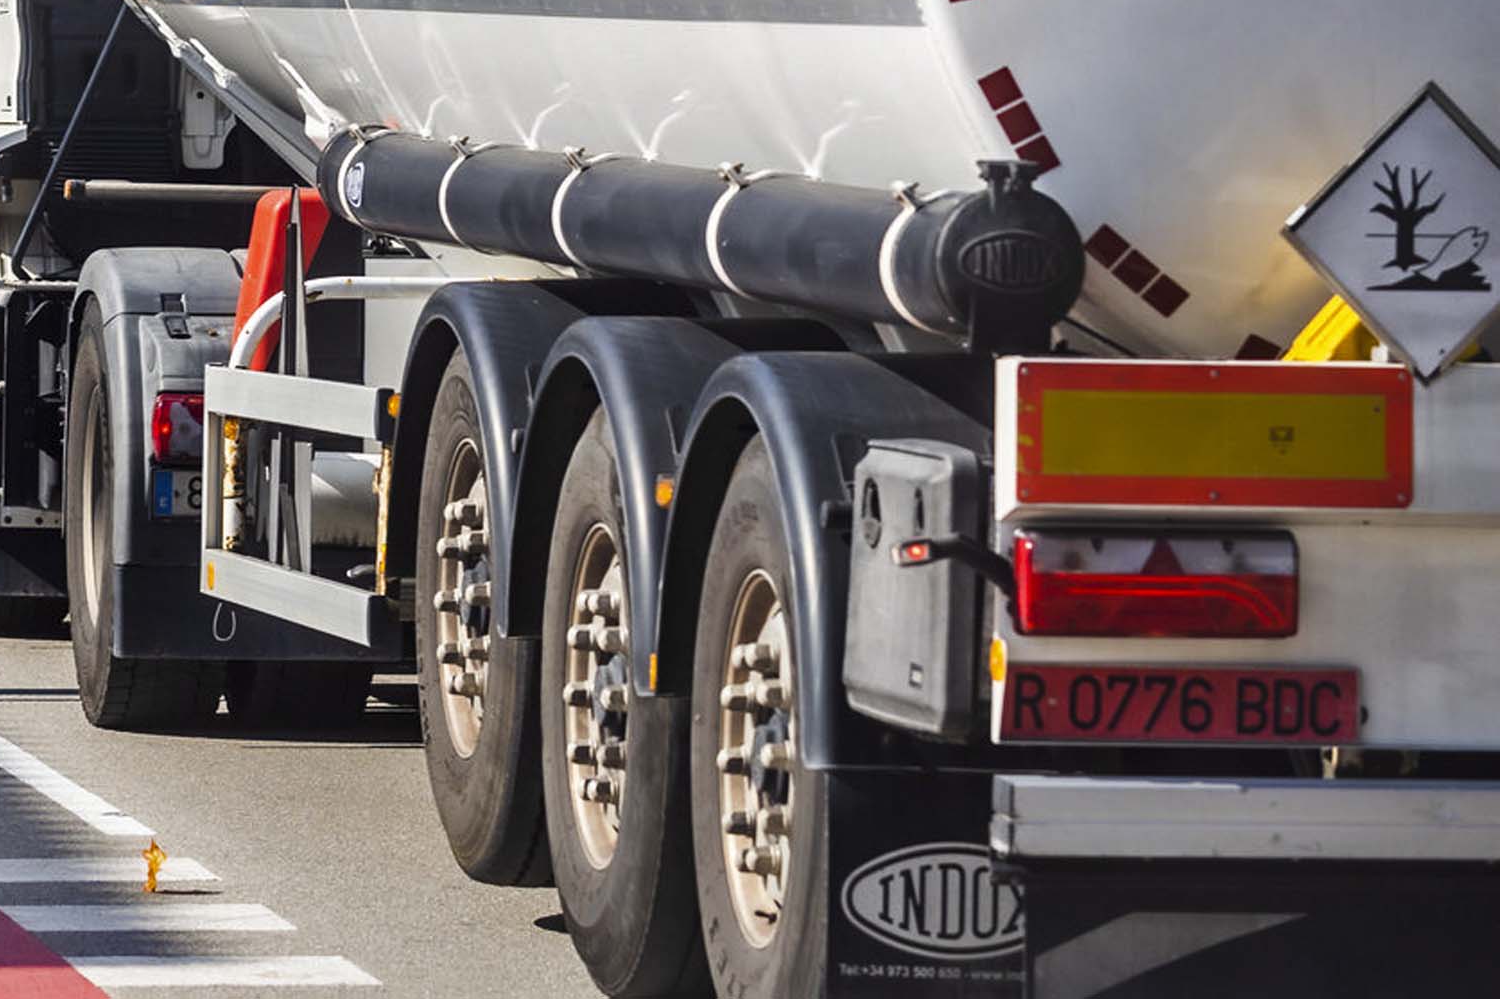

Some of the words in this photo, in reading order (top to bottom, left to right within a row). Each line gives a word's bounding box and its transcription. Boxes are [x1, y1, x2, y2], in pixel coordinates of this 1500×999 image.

[1013, 672, 1047, 730] R
[1067, 674, 1214, 734] 0776
[1235, 677, 1342, 737] BDC
